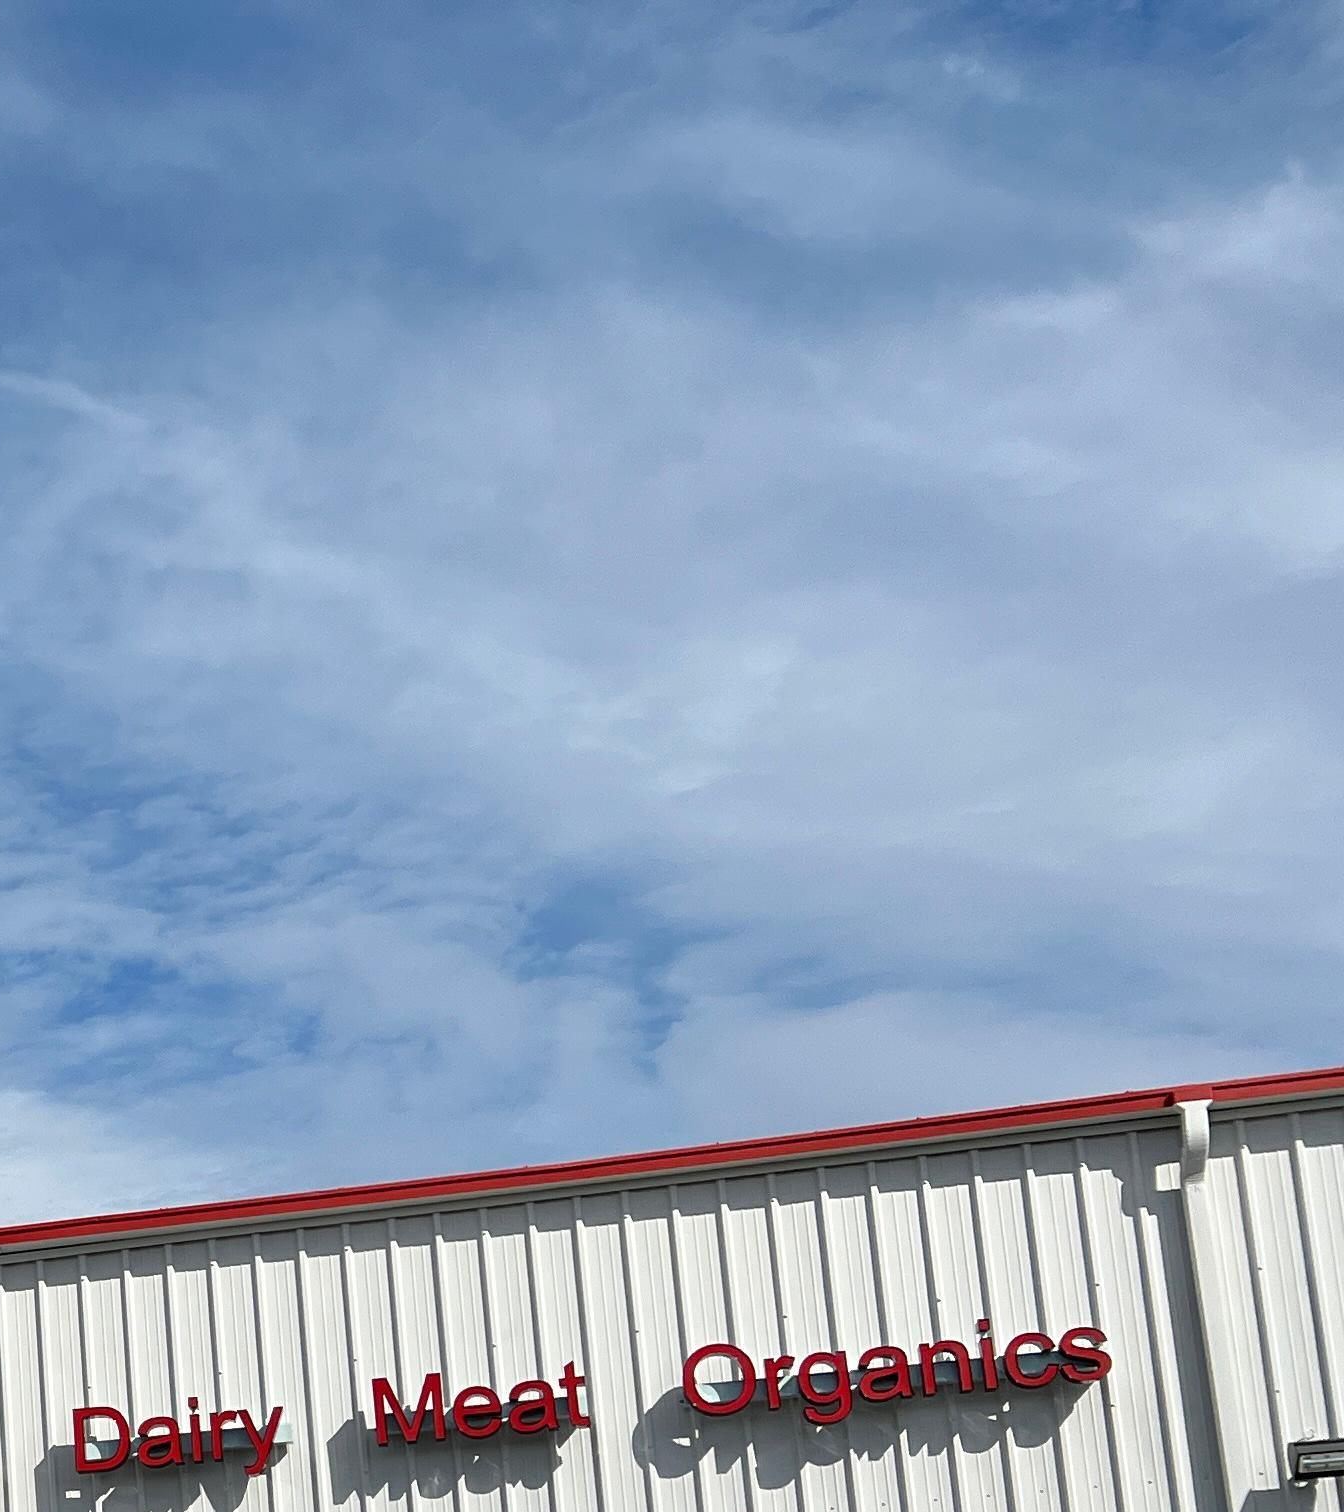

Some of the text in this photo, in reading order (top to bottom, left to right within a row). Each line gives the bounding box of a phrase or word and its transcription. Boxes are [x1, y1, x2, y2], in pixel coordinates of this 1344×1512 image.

[73, 1395, 284, 1478] Dairy
[370, 1360, 592, 1450] Meat
[679, 1317, 1114, 1427] Organics
